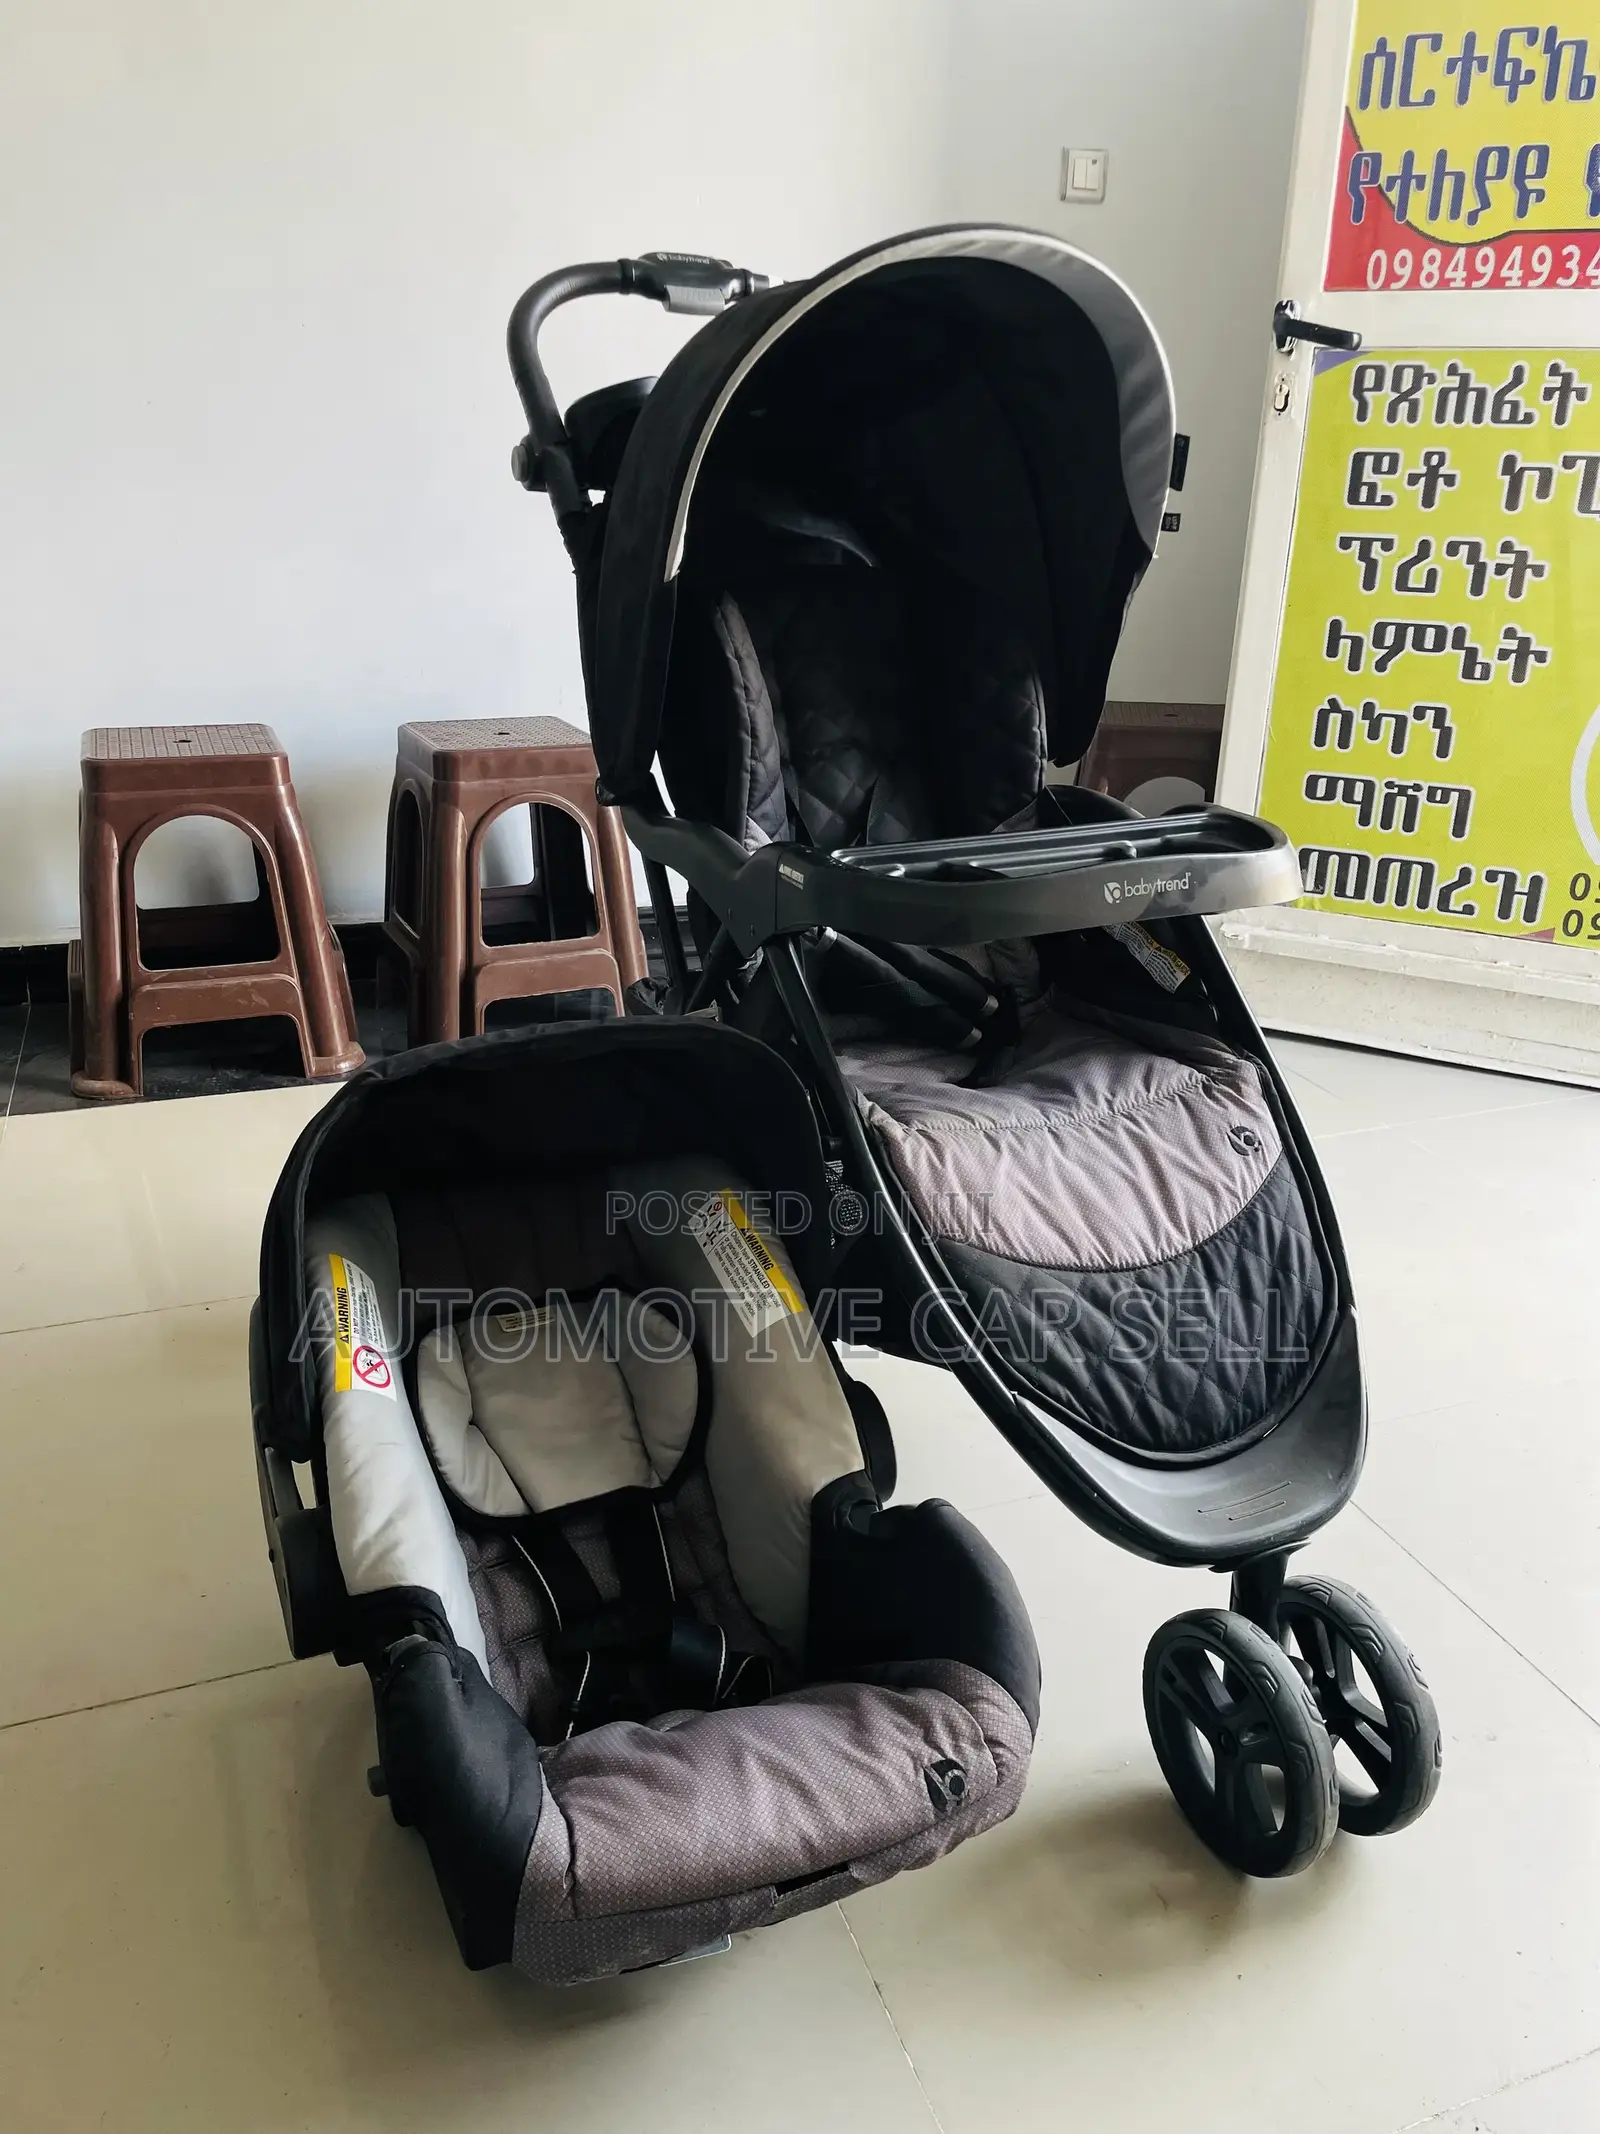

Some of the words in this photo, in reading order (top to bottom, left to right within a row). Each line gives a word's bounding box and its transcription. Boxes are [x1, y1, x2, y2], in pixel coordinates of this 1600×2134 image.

[1348, 144, 1550, 226] የተለያዩ
[1352, 362, 1589, 426] የጽሕፈት
[1346, 450, 1457, 509] ፎቶ
[1337, 535, 1545, 599] ፕሪንት
[1324, 618, 1549, 685] ላምኔት
[1312, 697, 1454, 760] ስካን
[1123, 872, 1191, 898] babytrend
[1297, 846, 1545, 925] መጠረዝ
[744, 1232, 774, 1271] WARNING
[746, 1257, 770, 1290] STRANGLED
[336, 1286, 348, 1332] WARNING
